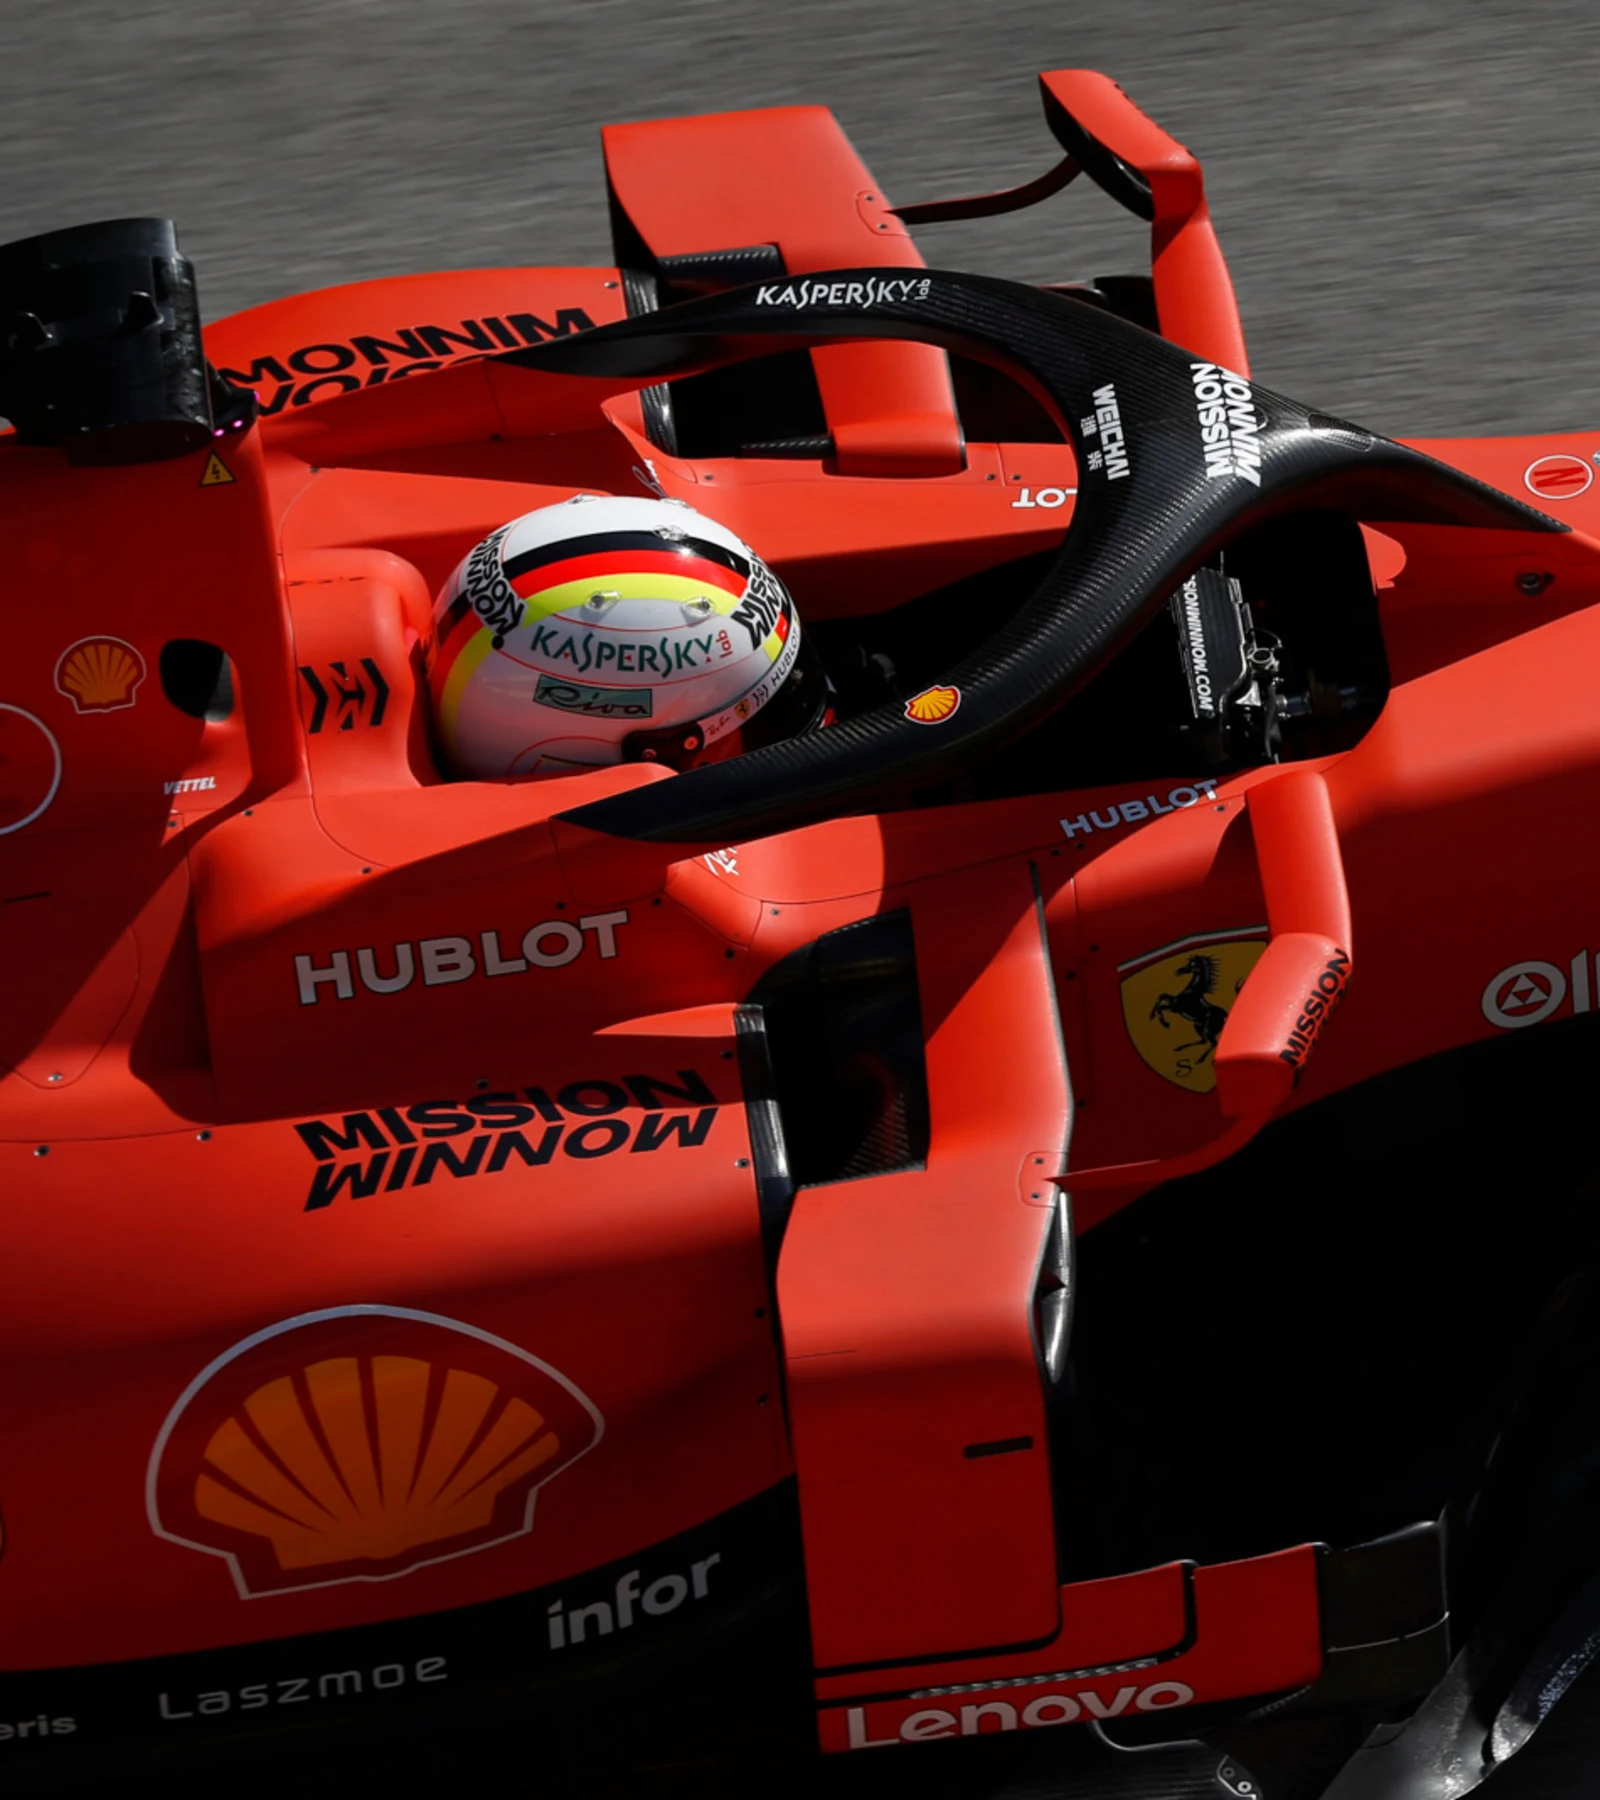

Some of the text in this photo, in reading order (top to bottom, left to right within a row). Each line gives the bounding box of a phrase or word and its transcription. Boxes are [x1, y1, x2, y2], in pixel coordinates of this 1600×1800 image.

[755, 277, 917, 310] KASPERSKY
[1092, 383, 1130, 480] WEICHAI
[1190, 363, 1234, 478] MISSION
[530, 625, 713, 678] KASPERSKY
[771, 627, 798, 686] HUBLOT
[537, 684, 649, 715] Riva
[164, 776, 216, 795] VETTEL
[1060, 779, 1218, 838] HUBLOT
[295, 910, 628, 1004] HUBLOT
[1280, 948, 1349, 1067] MISSION
[294, 1069, 719, 1161] MISSION
[303, 1107, 719, 1212] WINNOW
[548, 1552, 722, 1650] infor
[158, 1656, 449, 1720] Laszmoe
[846, 1681, 1194, 1751] Lenovo
